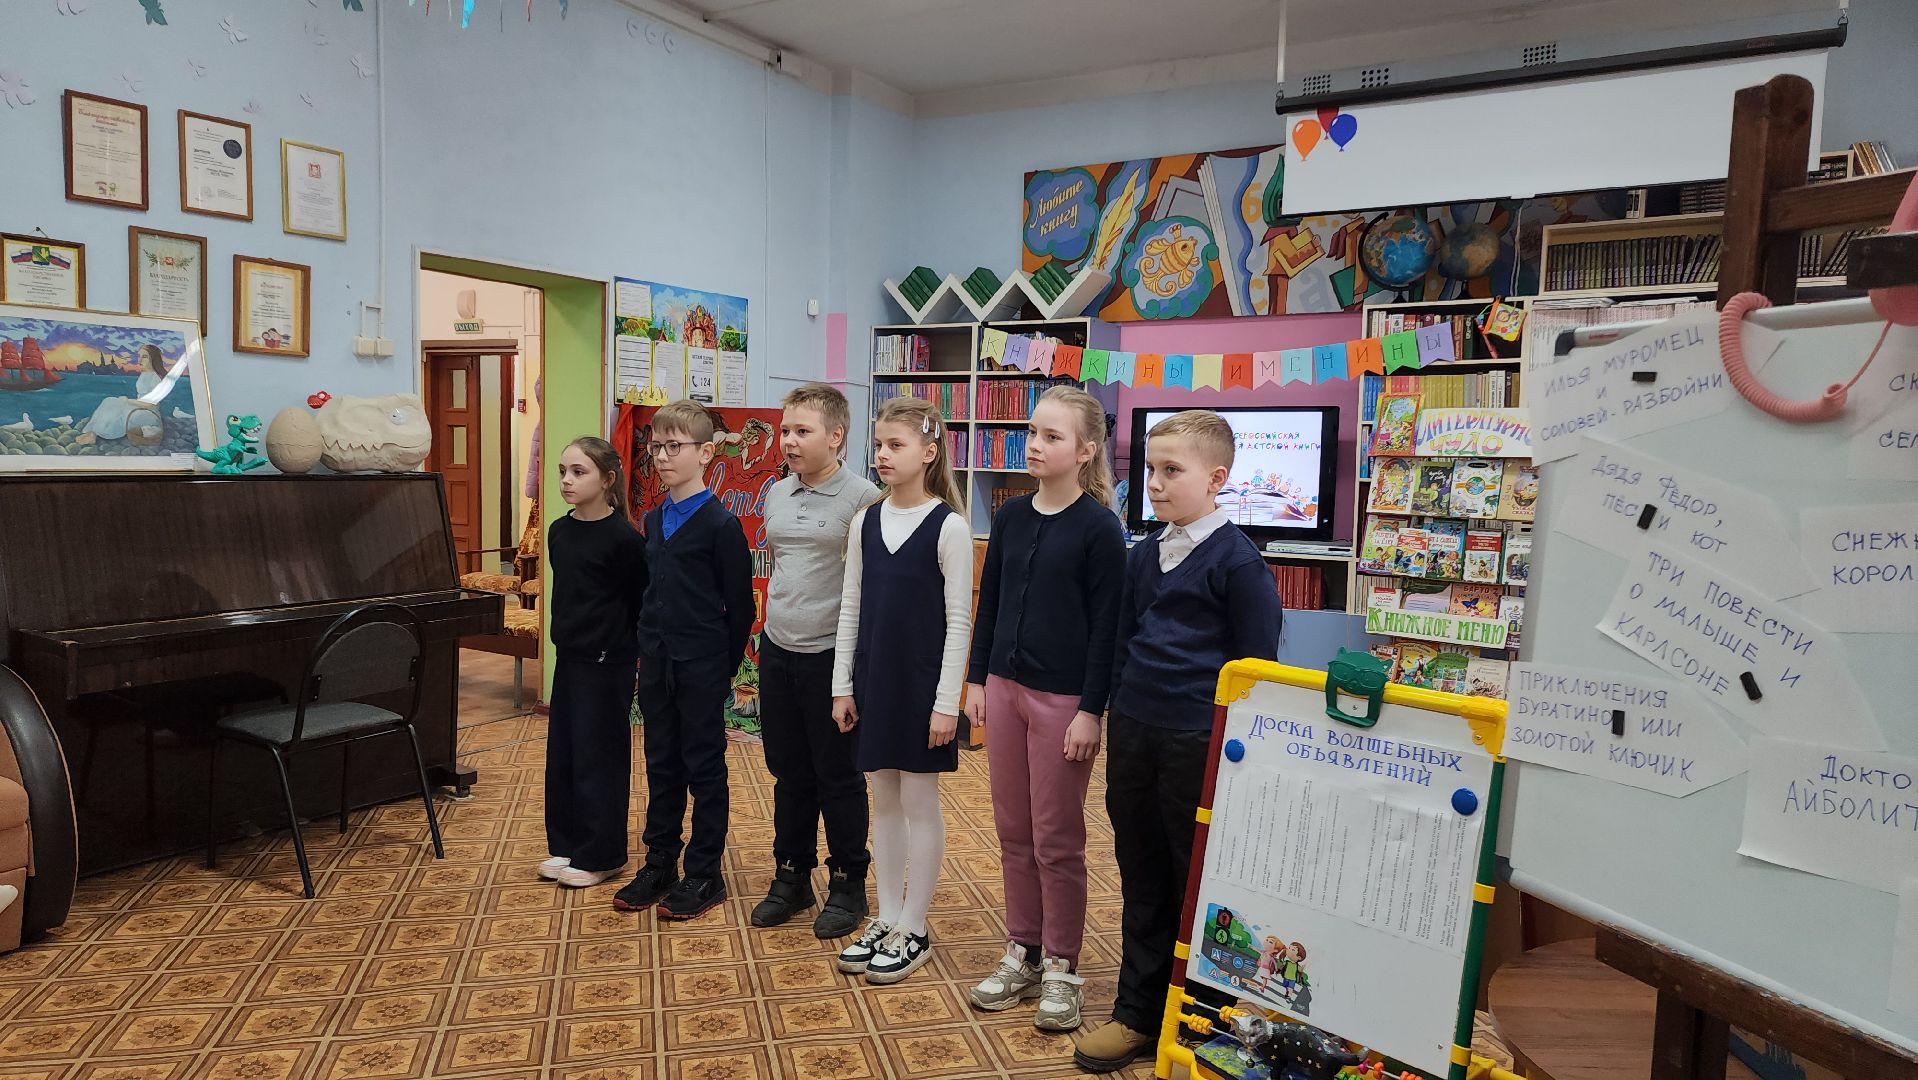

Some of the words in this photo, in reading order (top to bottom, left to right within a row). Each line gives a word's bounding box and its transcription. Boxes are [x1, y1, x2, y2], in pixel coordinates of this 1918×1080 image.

[1029, 180, 1083, 229] Любите
[1040, 203, 1078, 237] книгу
[1544, 366, 1591, 398] ИЛЬЯ
[1603, 325, 1704, 374] МУРОМЕЦ
[1233, 432, 1300, 440] СЕРОССИЙСКАЯ
[1429, 432, 1504, 457] ЧУДО
[1690, 530, 1728, 553] КОТ
[1648, 551, 1686, 587] ТРИ
[1704, 581, 1814, 656] ПОВЕСТИ
[1457, 620, 1505, 645] МЕНЮ
[1630, 583, 1643, 600] О
[1653, 596, 1759, 664] МАЛЫШЕ
[1779, 667, 1801, 689] И
[1614, 612, 1730, 696] КАРЛСОНЕ
[1519, 670, 1669, 709] ПРИКЛЮЧЕНИЯ
[1517, 696, 1614, 727] БУРАТИНО
[1641, 716, 1682, 737] ИЛИ
[1327, 729, 1463, 772] ВОЛШЕБНЫХ
[1511, 725, 1596, 755] ЗОЛОТОЙ
[1608, 743, 1695, 783] КЛЮЧИК
